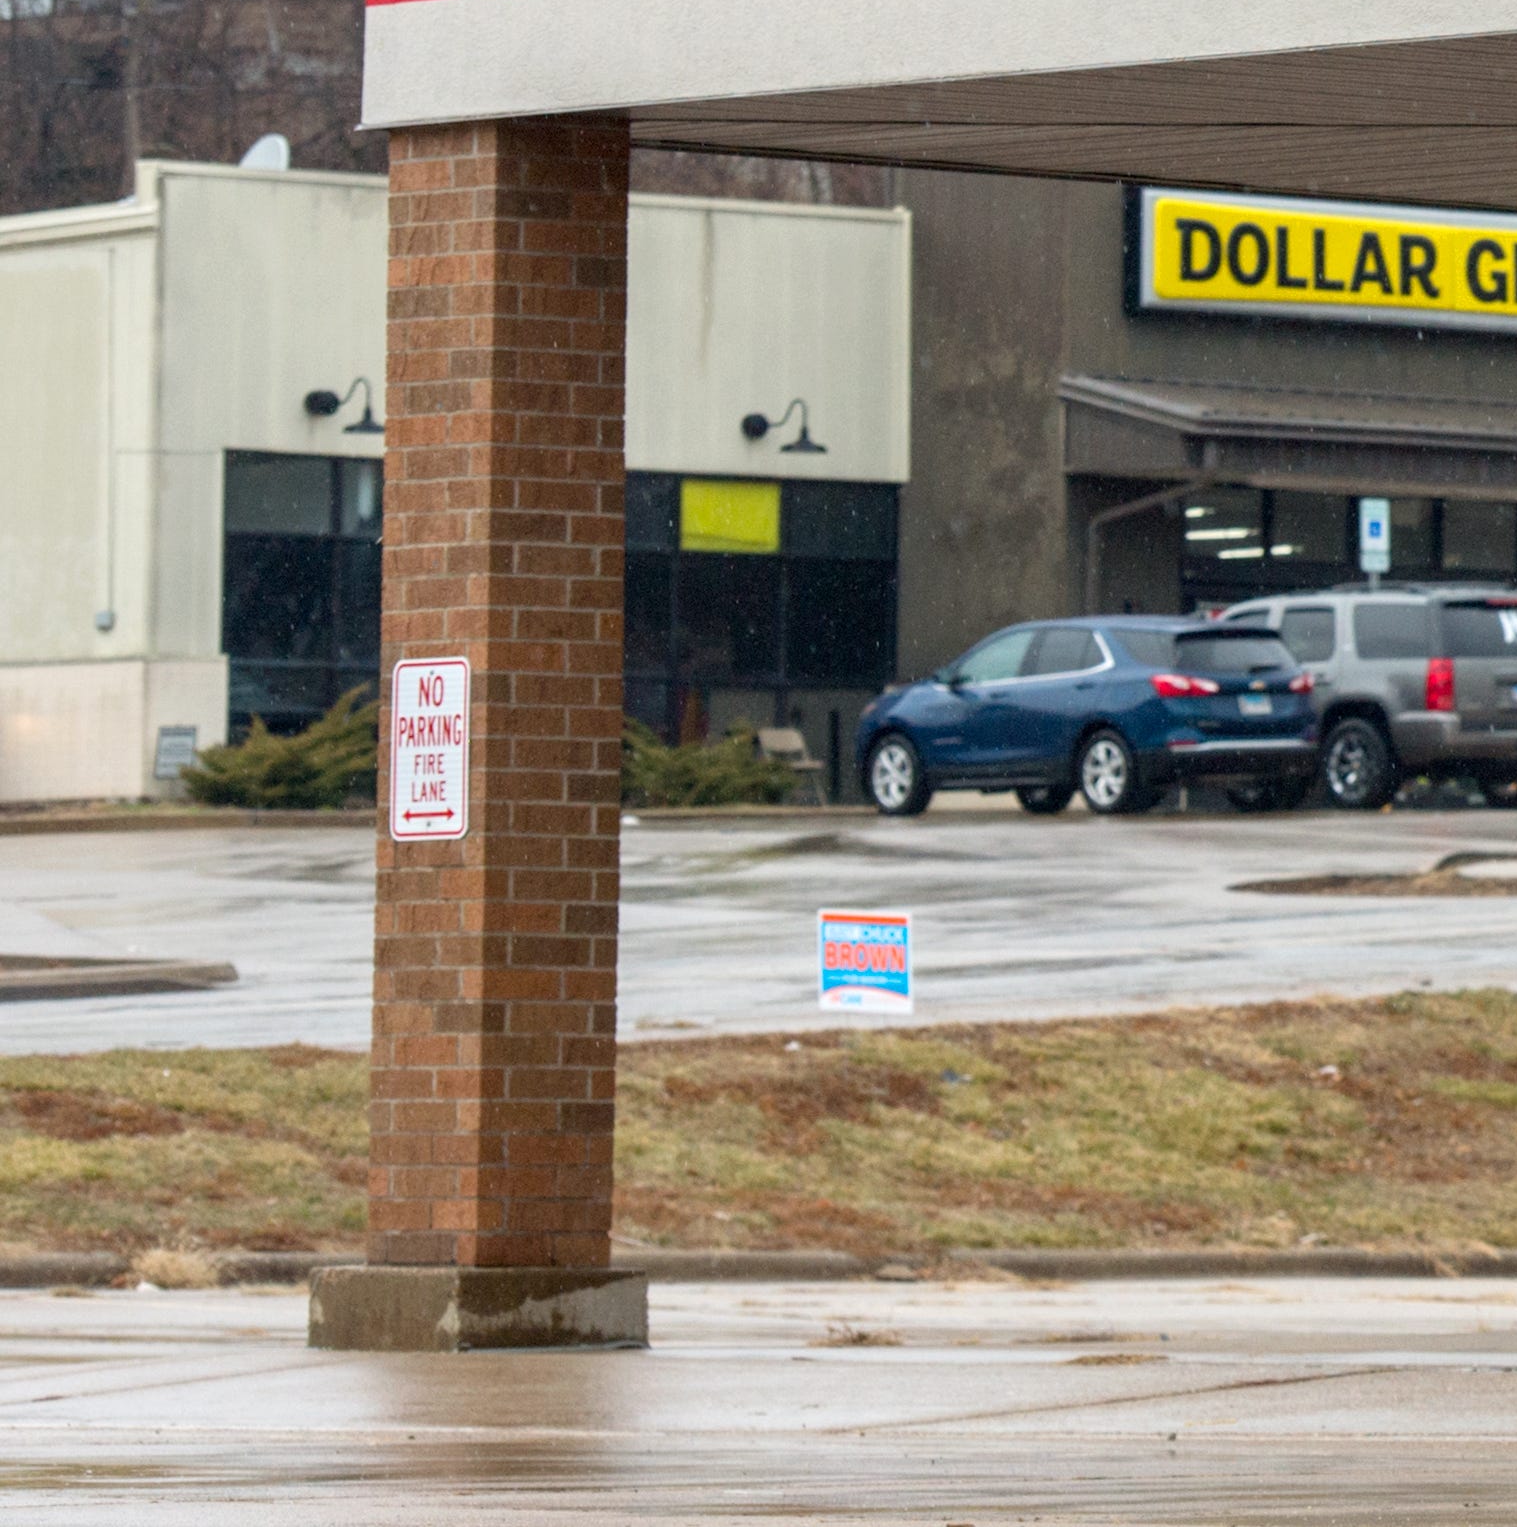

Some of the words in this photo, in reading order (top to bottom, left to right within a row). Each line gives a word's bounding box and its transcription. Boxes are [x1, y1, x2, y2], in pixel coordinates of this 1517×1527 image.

[1175, 218, 1440, 298] DOLLAR
[418, 675, 445, 708] NO
[399, 713, 463, 748] PARKING
[413, 753, 445, 775] FIRE
[411, 780, 447, 803] LANE
[824, 941, 905, 972] BROWN
